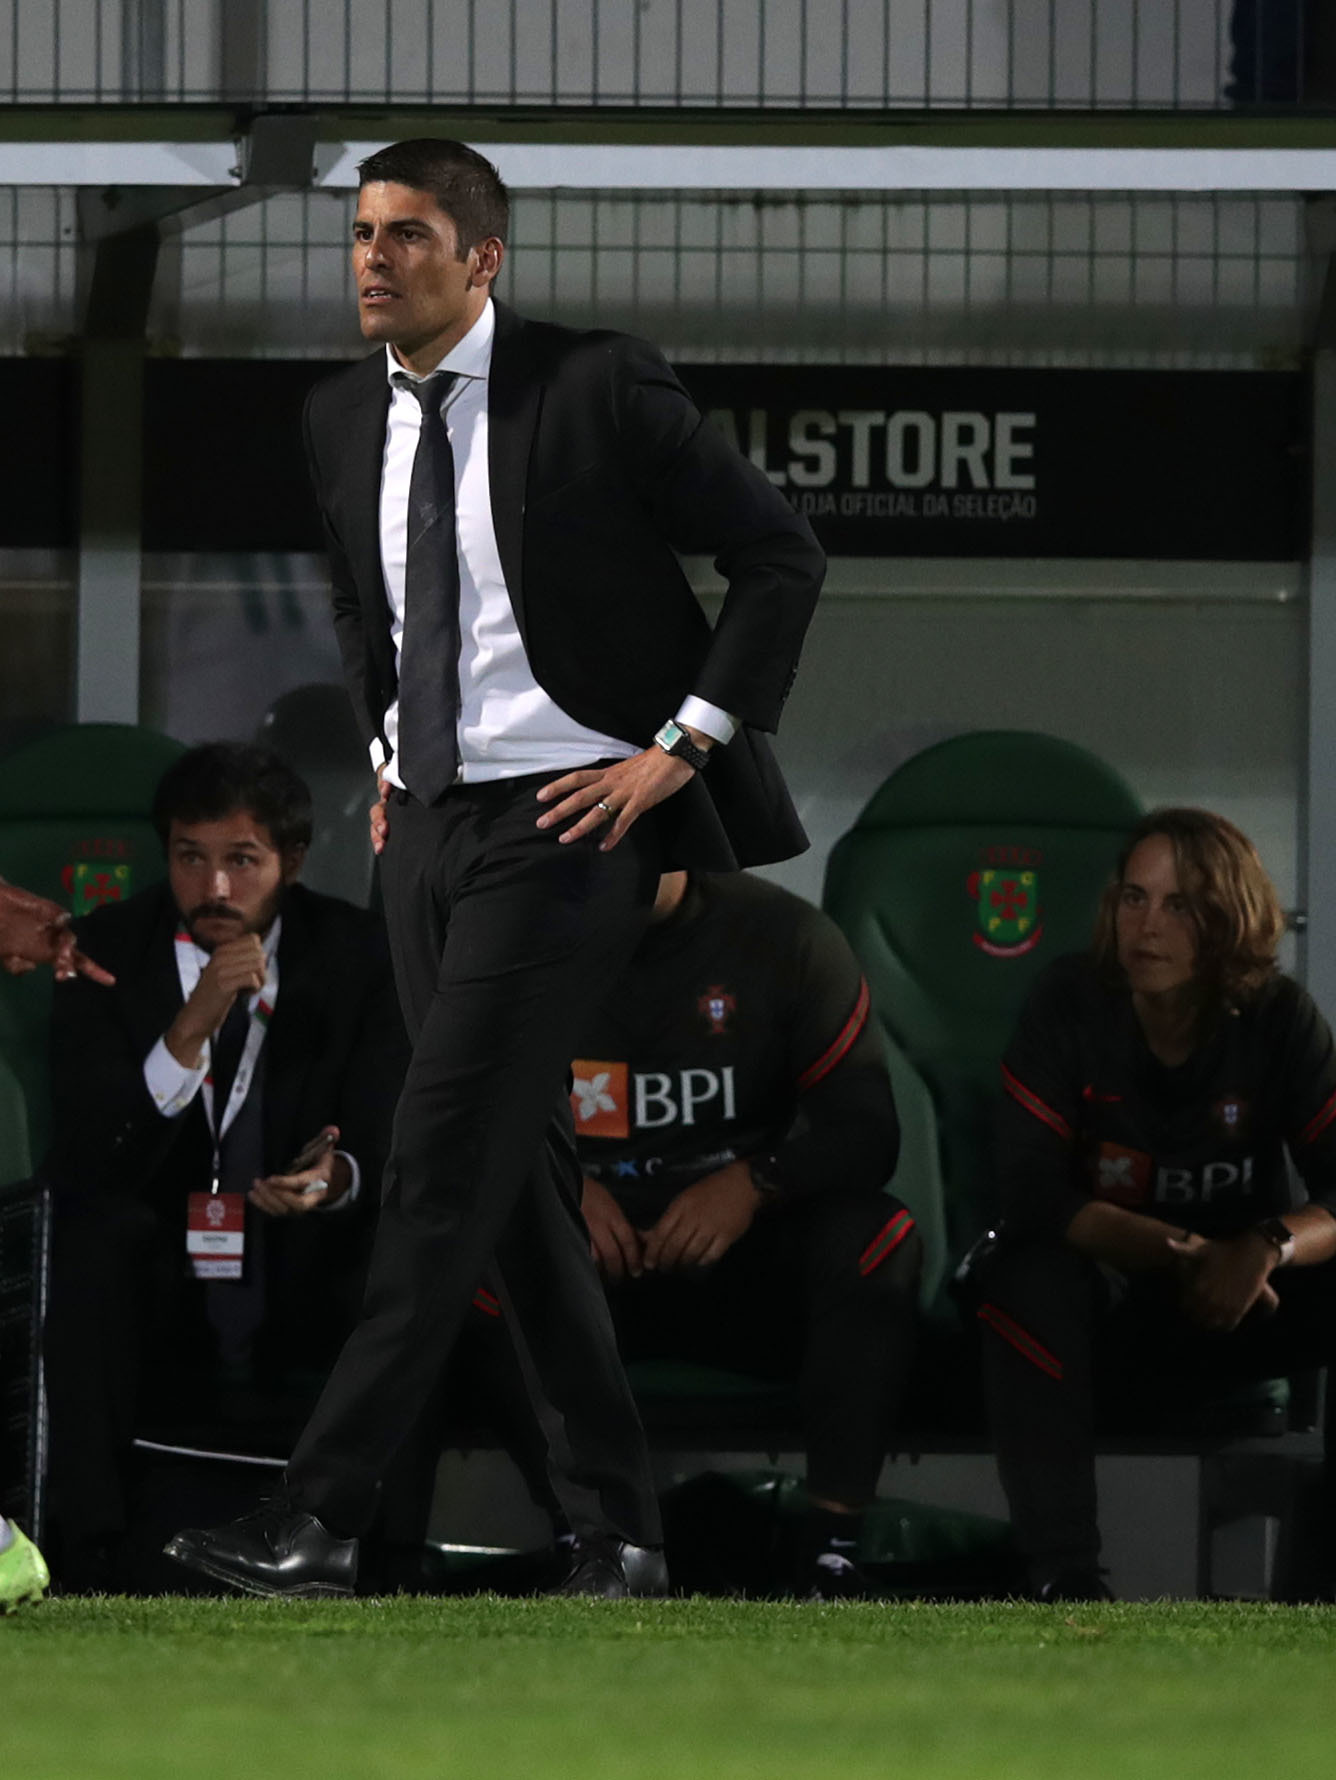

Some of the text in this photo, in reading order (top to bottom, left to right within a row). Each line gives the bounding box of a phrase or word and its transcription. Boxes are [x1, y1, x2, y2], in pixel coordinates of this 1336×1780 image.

[841, 491, 919, 517] OFICIAL
[922, 492, 949, 517] DA
[952, 489, 1037, 524] SELEÇÃO
[633, 1065, 738, 1130] BPI
[1154, 1155, 1257, 1204] BPI
